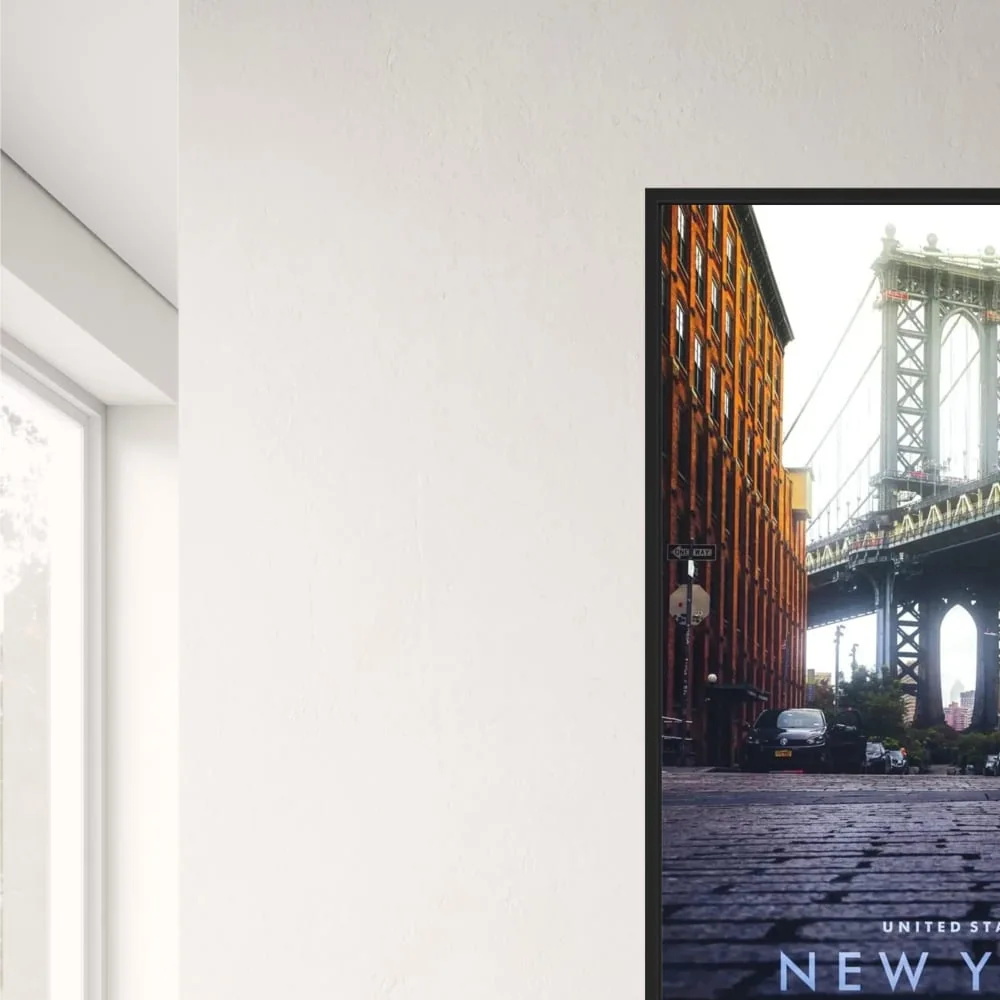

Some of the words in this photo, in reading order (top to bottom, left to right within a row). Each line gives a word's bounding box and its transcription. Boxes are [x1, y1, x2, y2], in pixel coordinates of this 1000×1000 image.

[694, 548, 711, 556] WAY
[882, 920, 960, 934] UNITED
[780, 950, 929, 992] NEW
